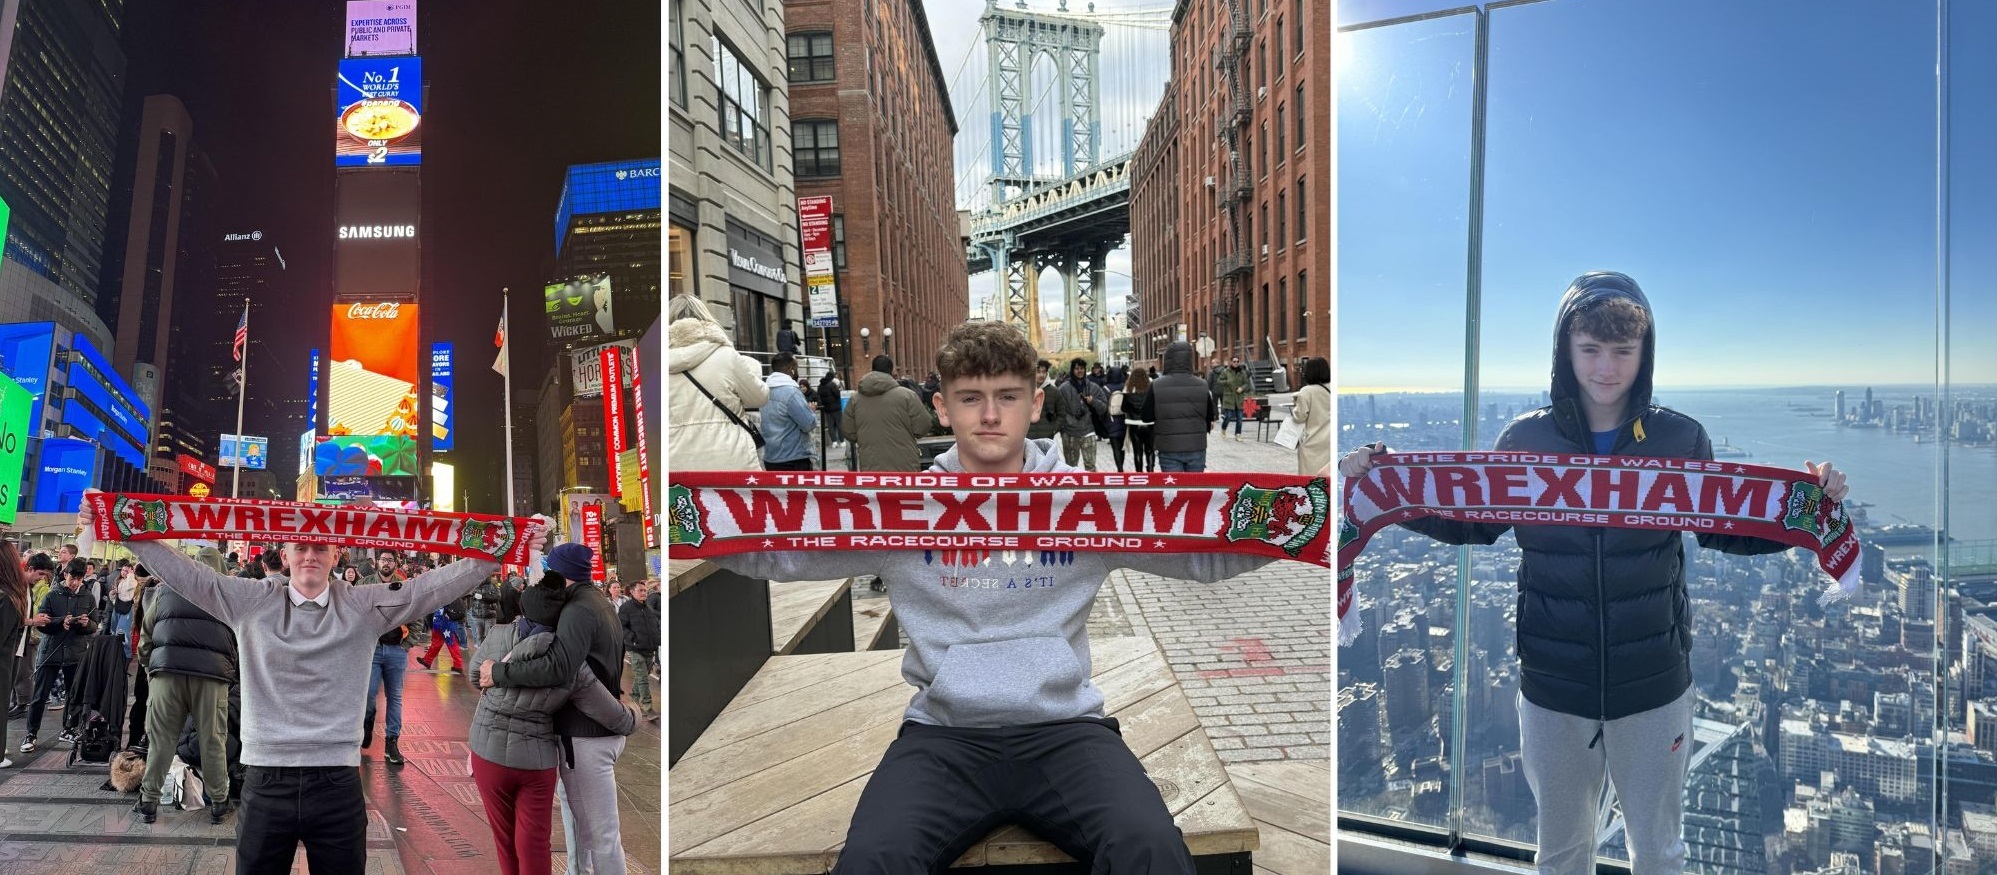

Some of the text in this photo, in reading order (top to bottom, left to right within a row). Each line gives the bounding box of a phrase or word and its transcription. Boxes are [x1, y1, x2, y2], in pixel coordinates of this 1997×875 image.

[351, 17, 407, 26] EXPERTISE ACROSS
[387, 25, 411, 33] PRIVATE
[351, 34, 379, 42] MARKETS
[362, 83, 399, 91] WORLD'S
[367, 147, 388, 163] $2
[224, 233, 250, 241] Allianz
[339, 225, 415, 239] SAMSUNG
[811, 285, 818, 294] 2
[347, 302, 400, 319] Coca-Cola
[15, 376, 38, 384] Stanley
[610, 385, 618, 414] PREMIUM
[612, 416, 621, 451] COMMON
[637, 411, 648, 472] CHOCOLATE
[1392, 454, 1723, 472] THE PRIDE OF WALES
[44, 466, 87, 477] Morgan Stanley
[776, 474, 1149, 487] THE PRIDE OF WALES
[1357, 466, 1773, 519] WREXHAM
[257, 499, 318, 508] PRIDE
[94, 495, 110, 540] WREXHAM
[713, 489, 1213, 535] WREXHAM
[1419, 507, 1714, 528] THE RACECOURSE GROUND
[178, 503, 455, 544] WREXHAM
[215, 532, 414, 549] THE RACECOURSE GROUND
[787, 536, 1142, 548] THE RACECOURSE GROUND
